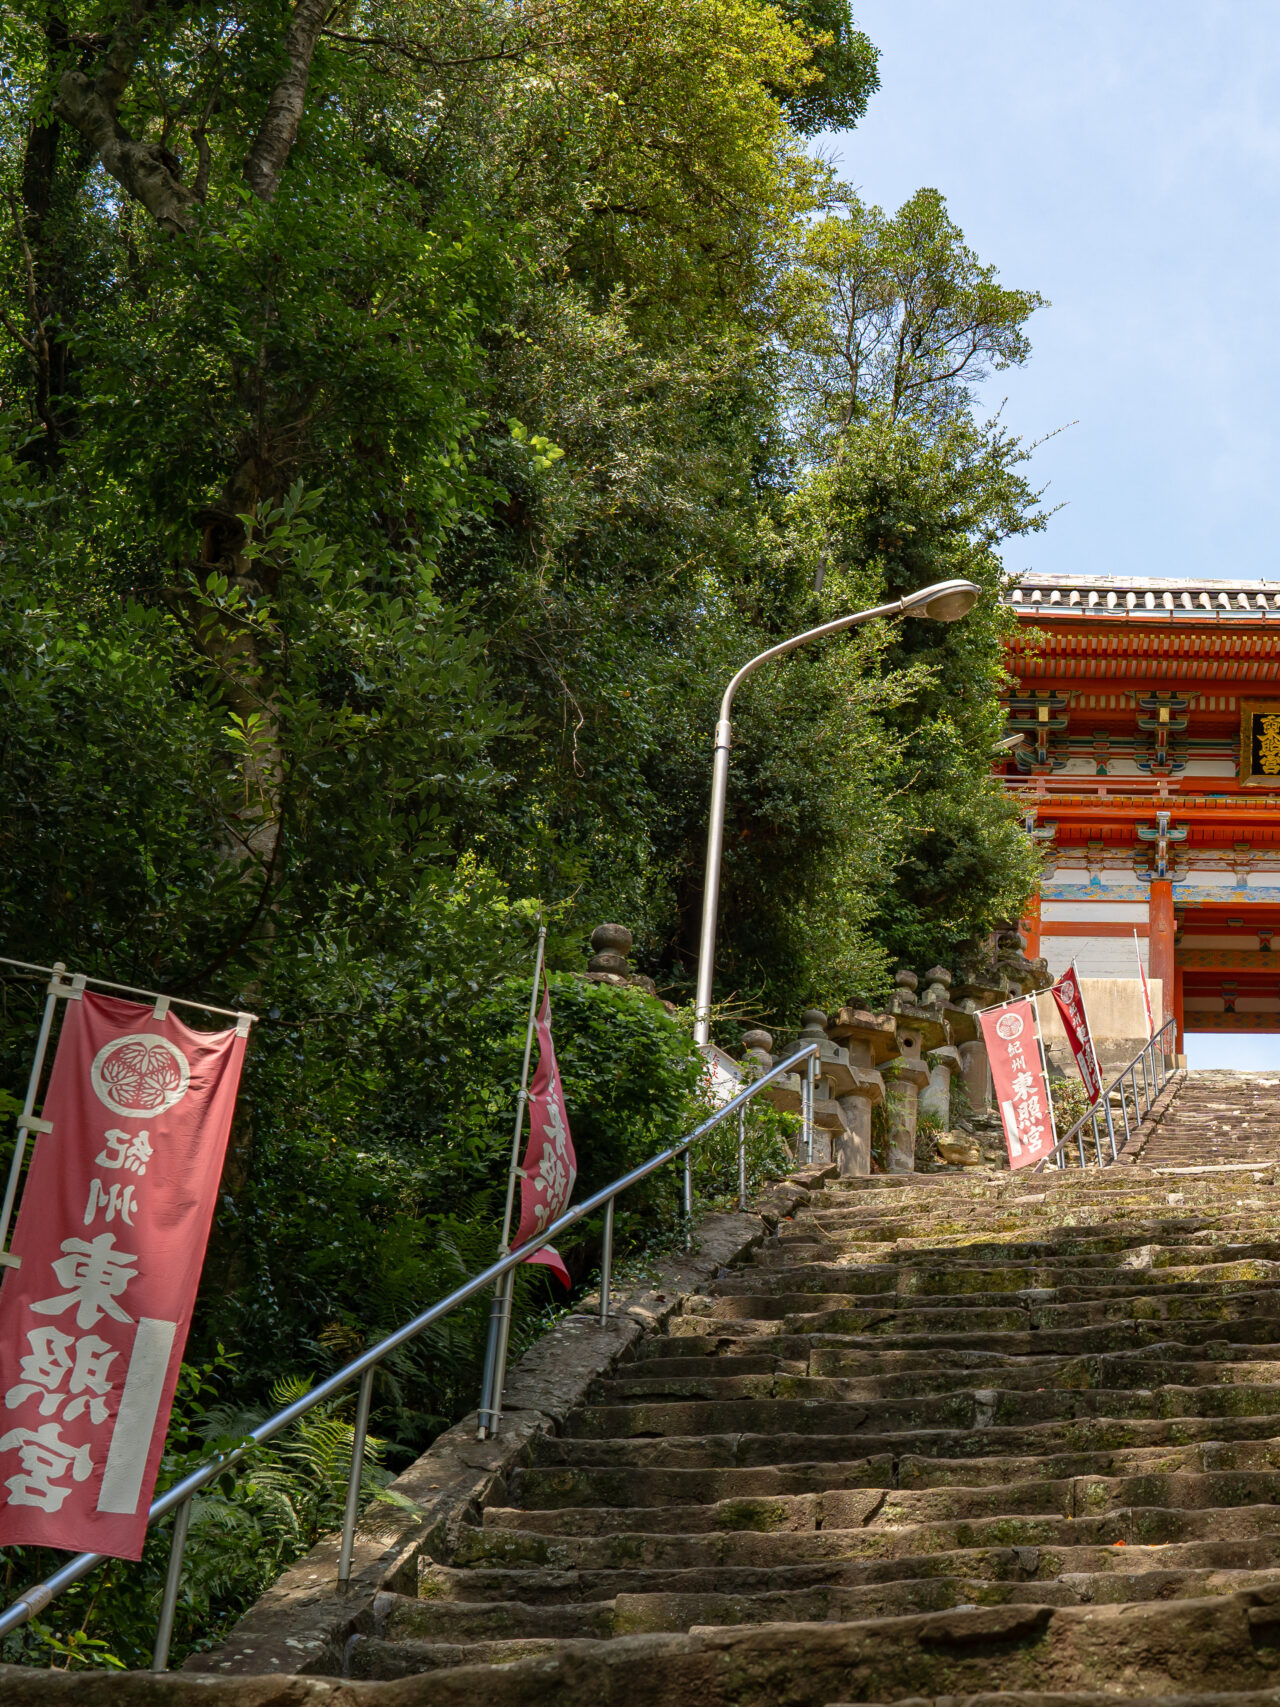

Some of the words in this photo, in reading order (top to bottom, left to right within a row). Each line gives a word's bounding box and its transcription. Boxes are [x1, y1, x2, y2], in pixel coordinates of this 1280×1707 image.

[1008, 1041, 1044, 1153] 紀州東照宮
